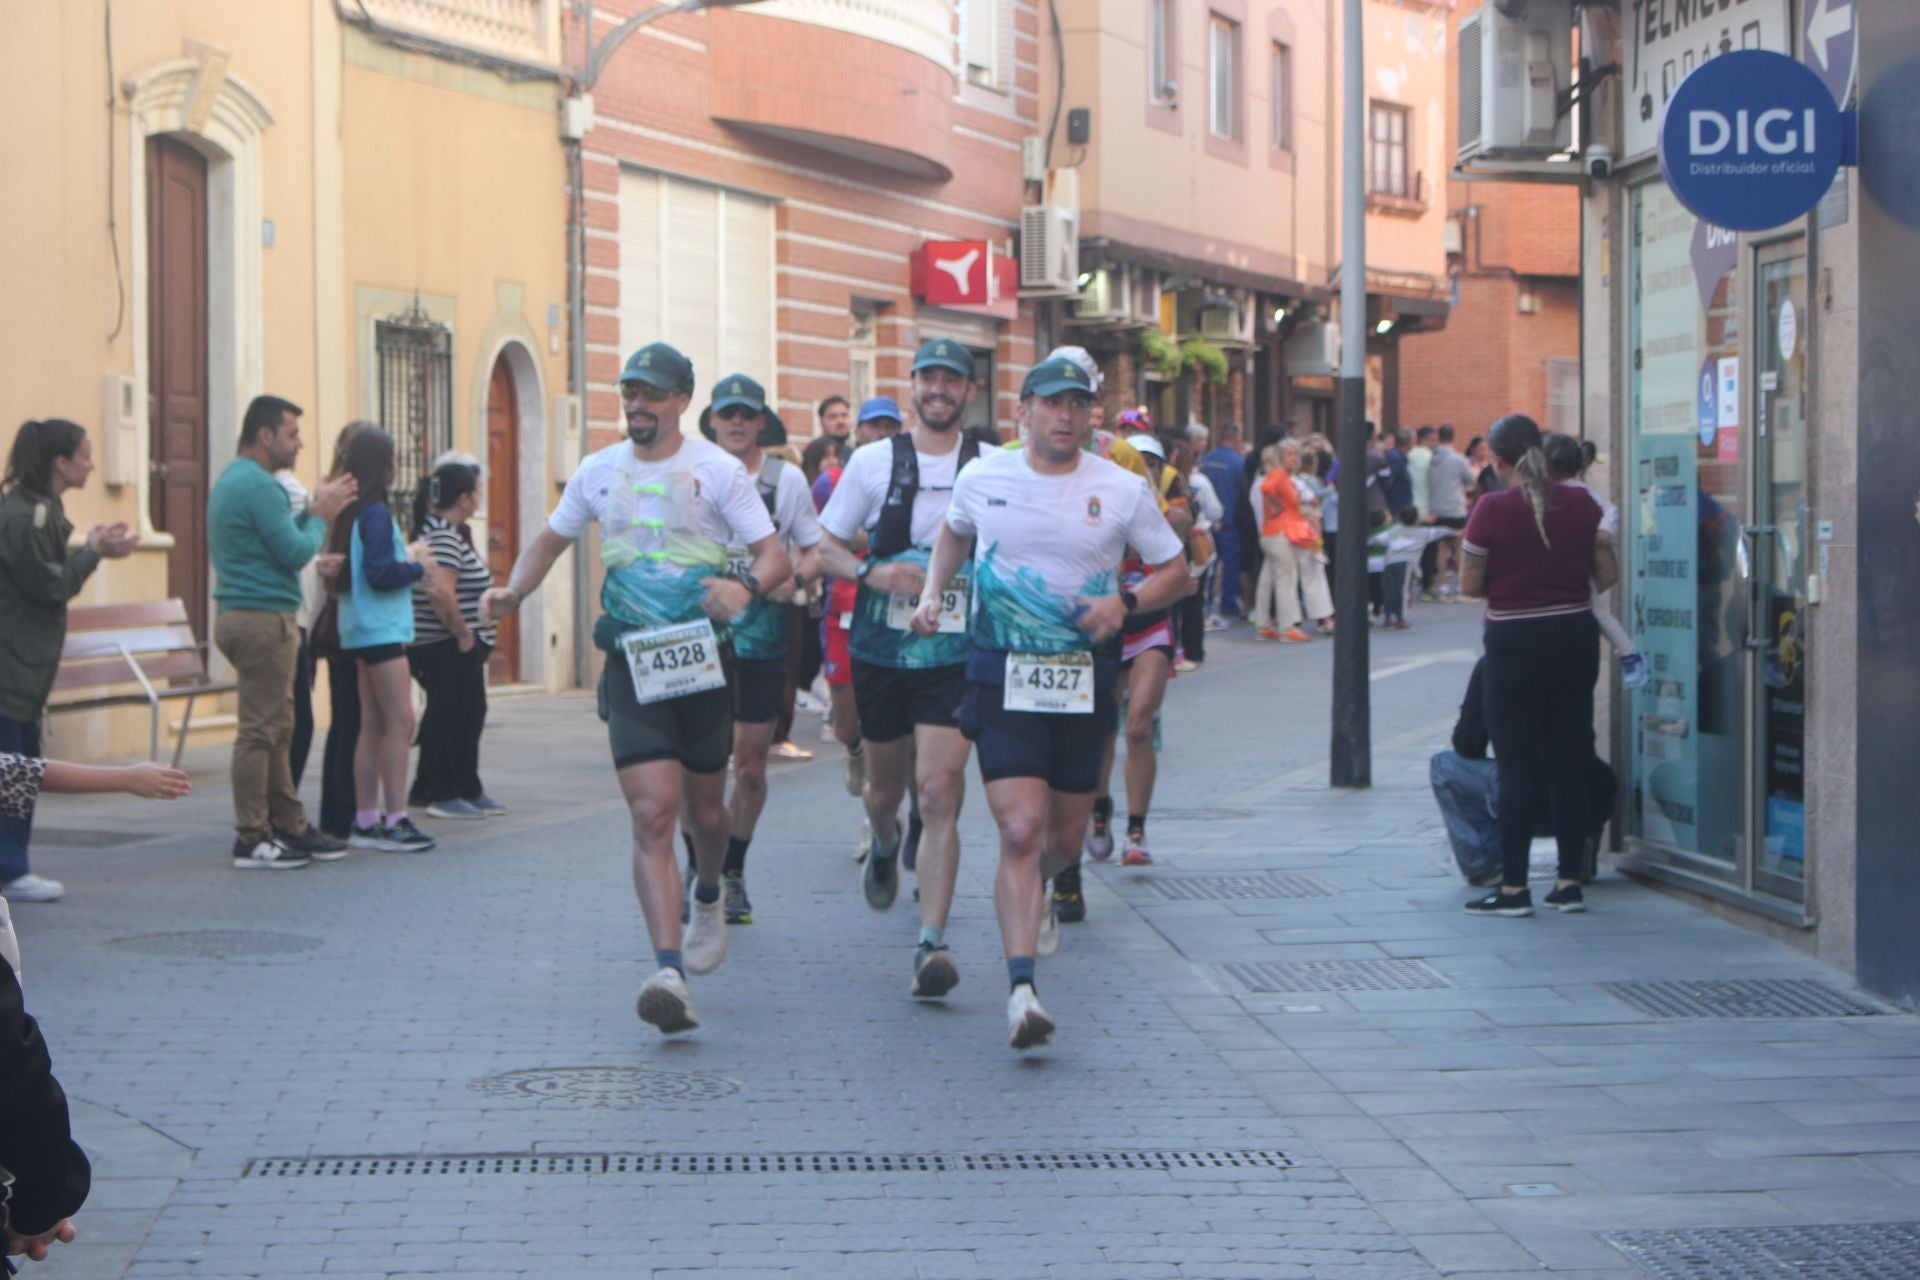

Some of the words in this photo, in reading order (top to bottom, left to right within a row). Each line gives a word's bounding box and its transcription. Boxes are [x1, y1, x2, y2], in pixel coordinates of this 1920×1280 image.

[1689, 108, 1815, 155] DIGI
[1689, 161, 1768, 175] Distribuidor
[1771, 159, 1815, 173] oficial
[908, 593, 957, 612] 49
[652, 642, 706, 671] 4328
[1028, 667, 1082, 690] 4327
